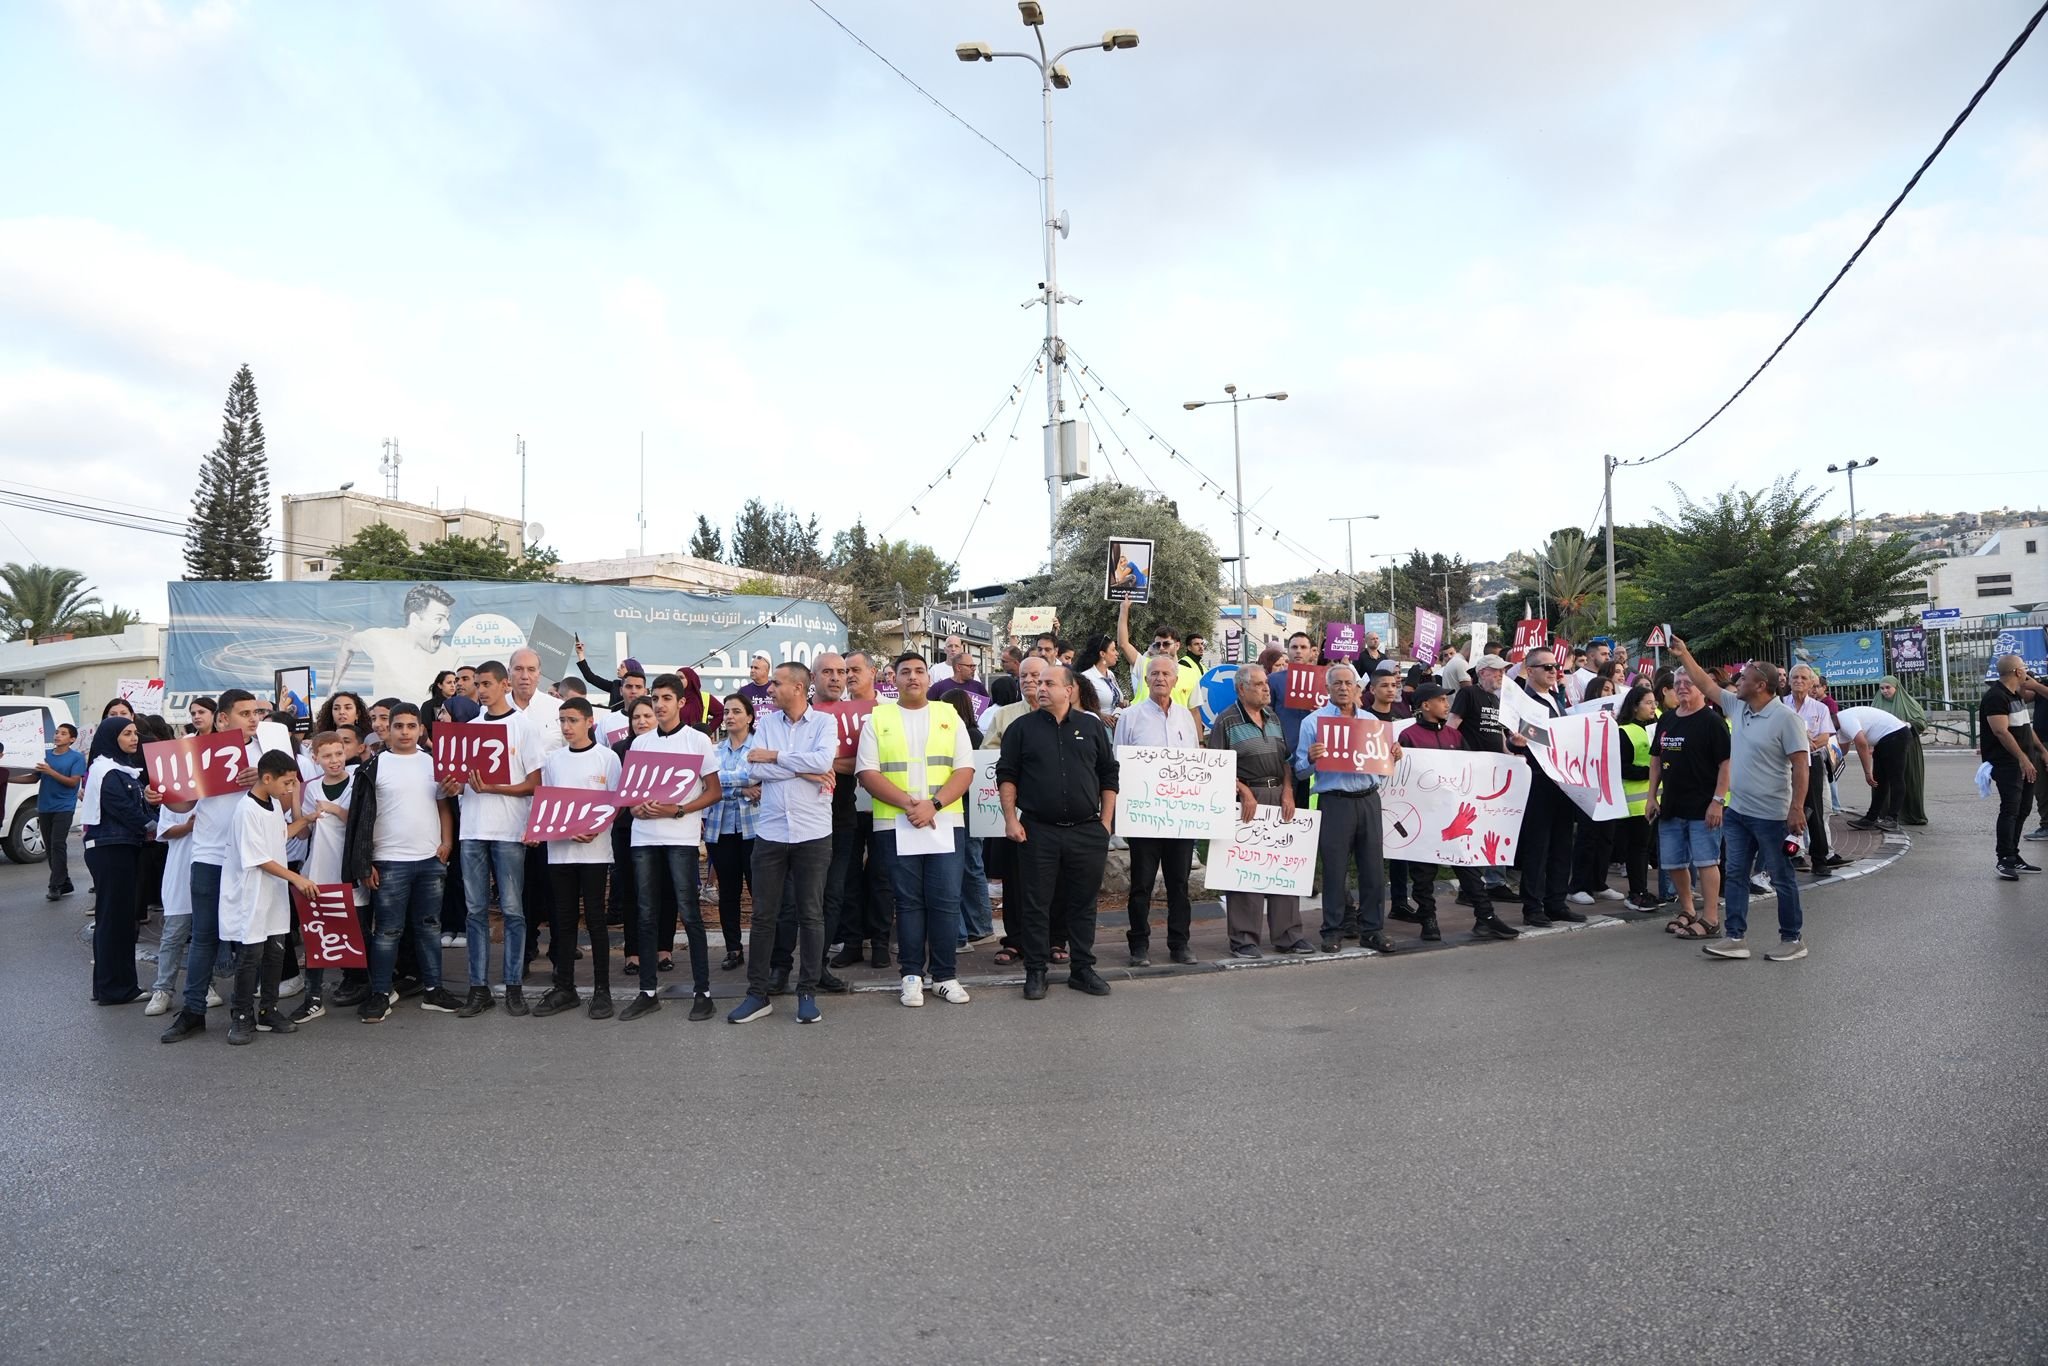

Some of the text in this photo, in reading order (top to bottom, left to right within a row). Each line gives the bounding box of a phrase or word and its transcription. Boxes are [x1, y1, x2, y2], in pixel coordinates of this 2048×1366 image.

[613, 606, 642, 619] حتى
[645, 607, 670, 623] تصل
[672, 608, 709, 626] بسرعة
[1207, 753, 1230, 768] على
[1178, 818, 1211, 838] בטחון
